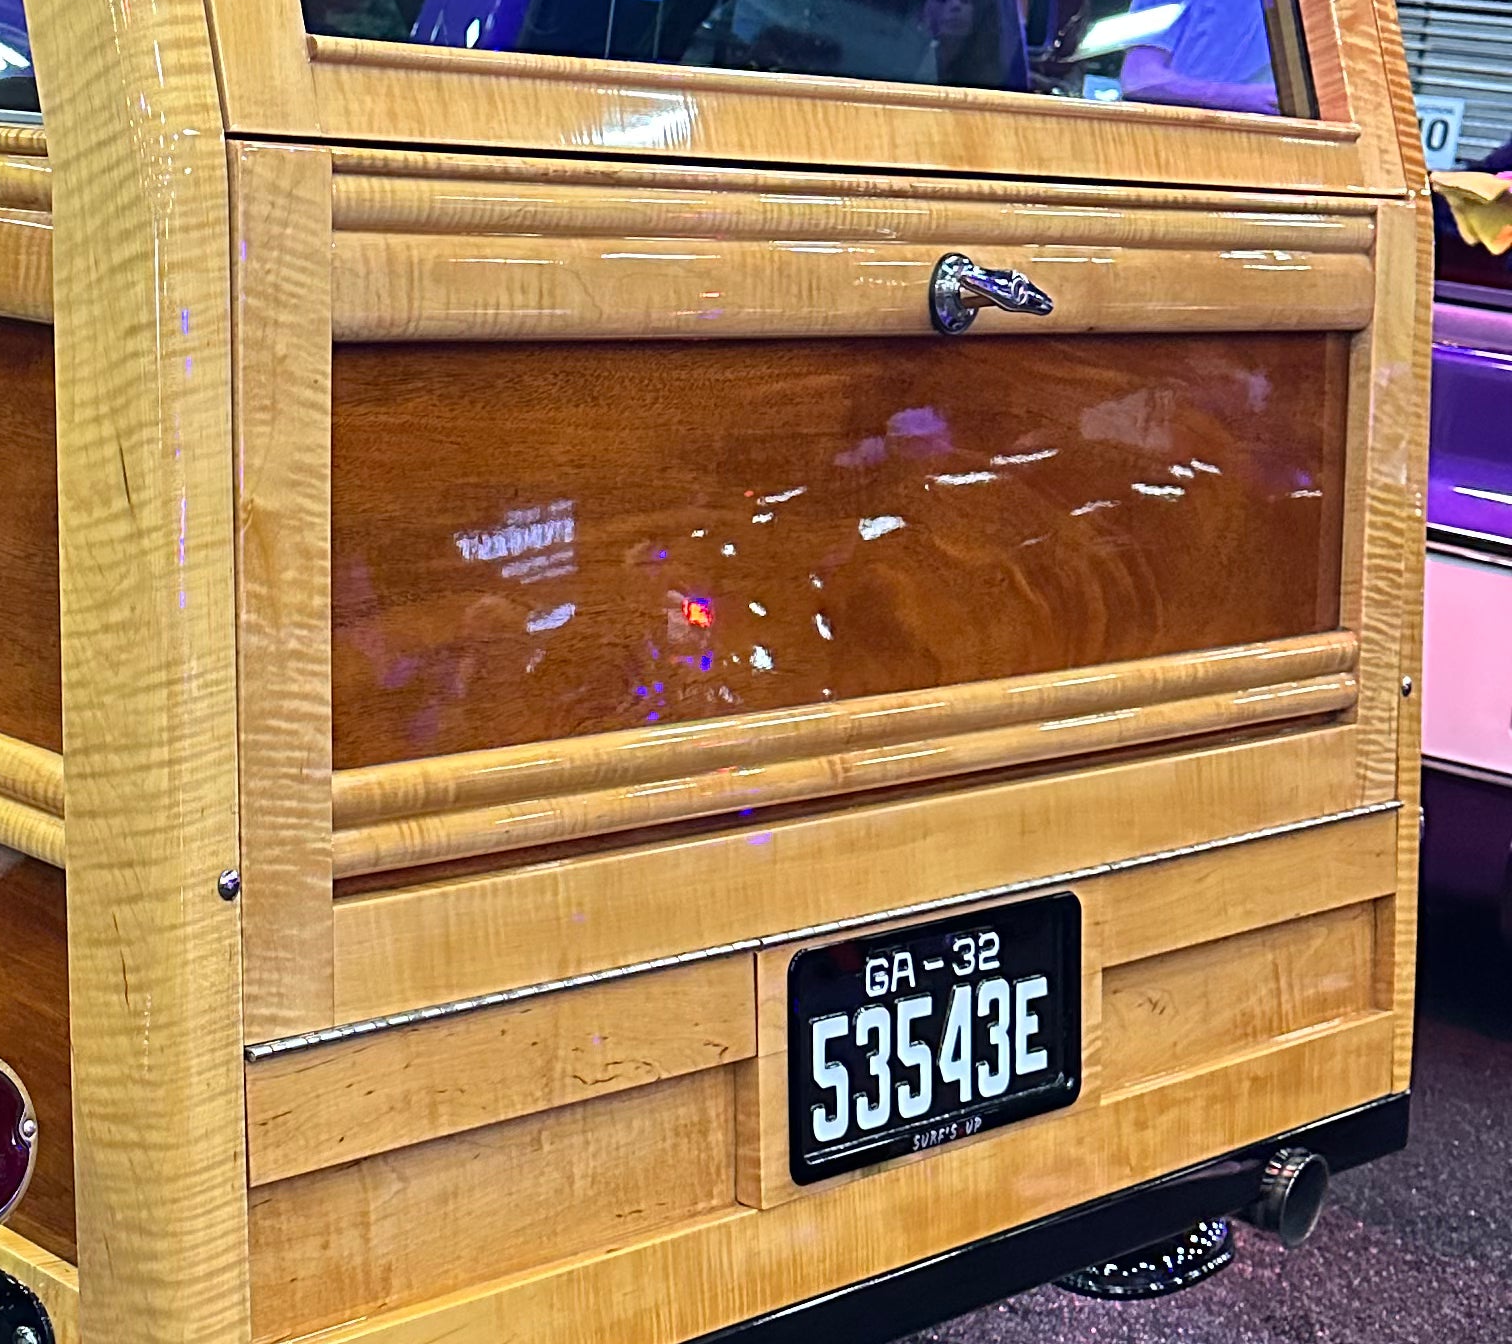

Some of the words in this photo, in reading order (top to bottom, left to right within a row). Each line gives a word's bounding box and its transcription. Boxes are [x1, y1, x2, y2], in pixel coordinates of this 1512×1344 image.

[811, 975, 1049, 1143] 53543E
[912, 1123, 958, 1152] SURF'S
[965, 1116, 982, 1135] UP
